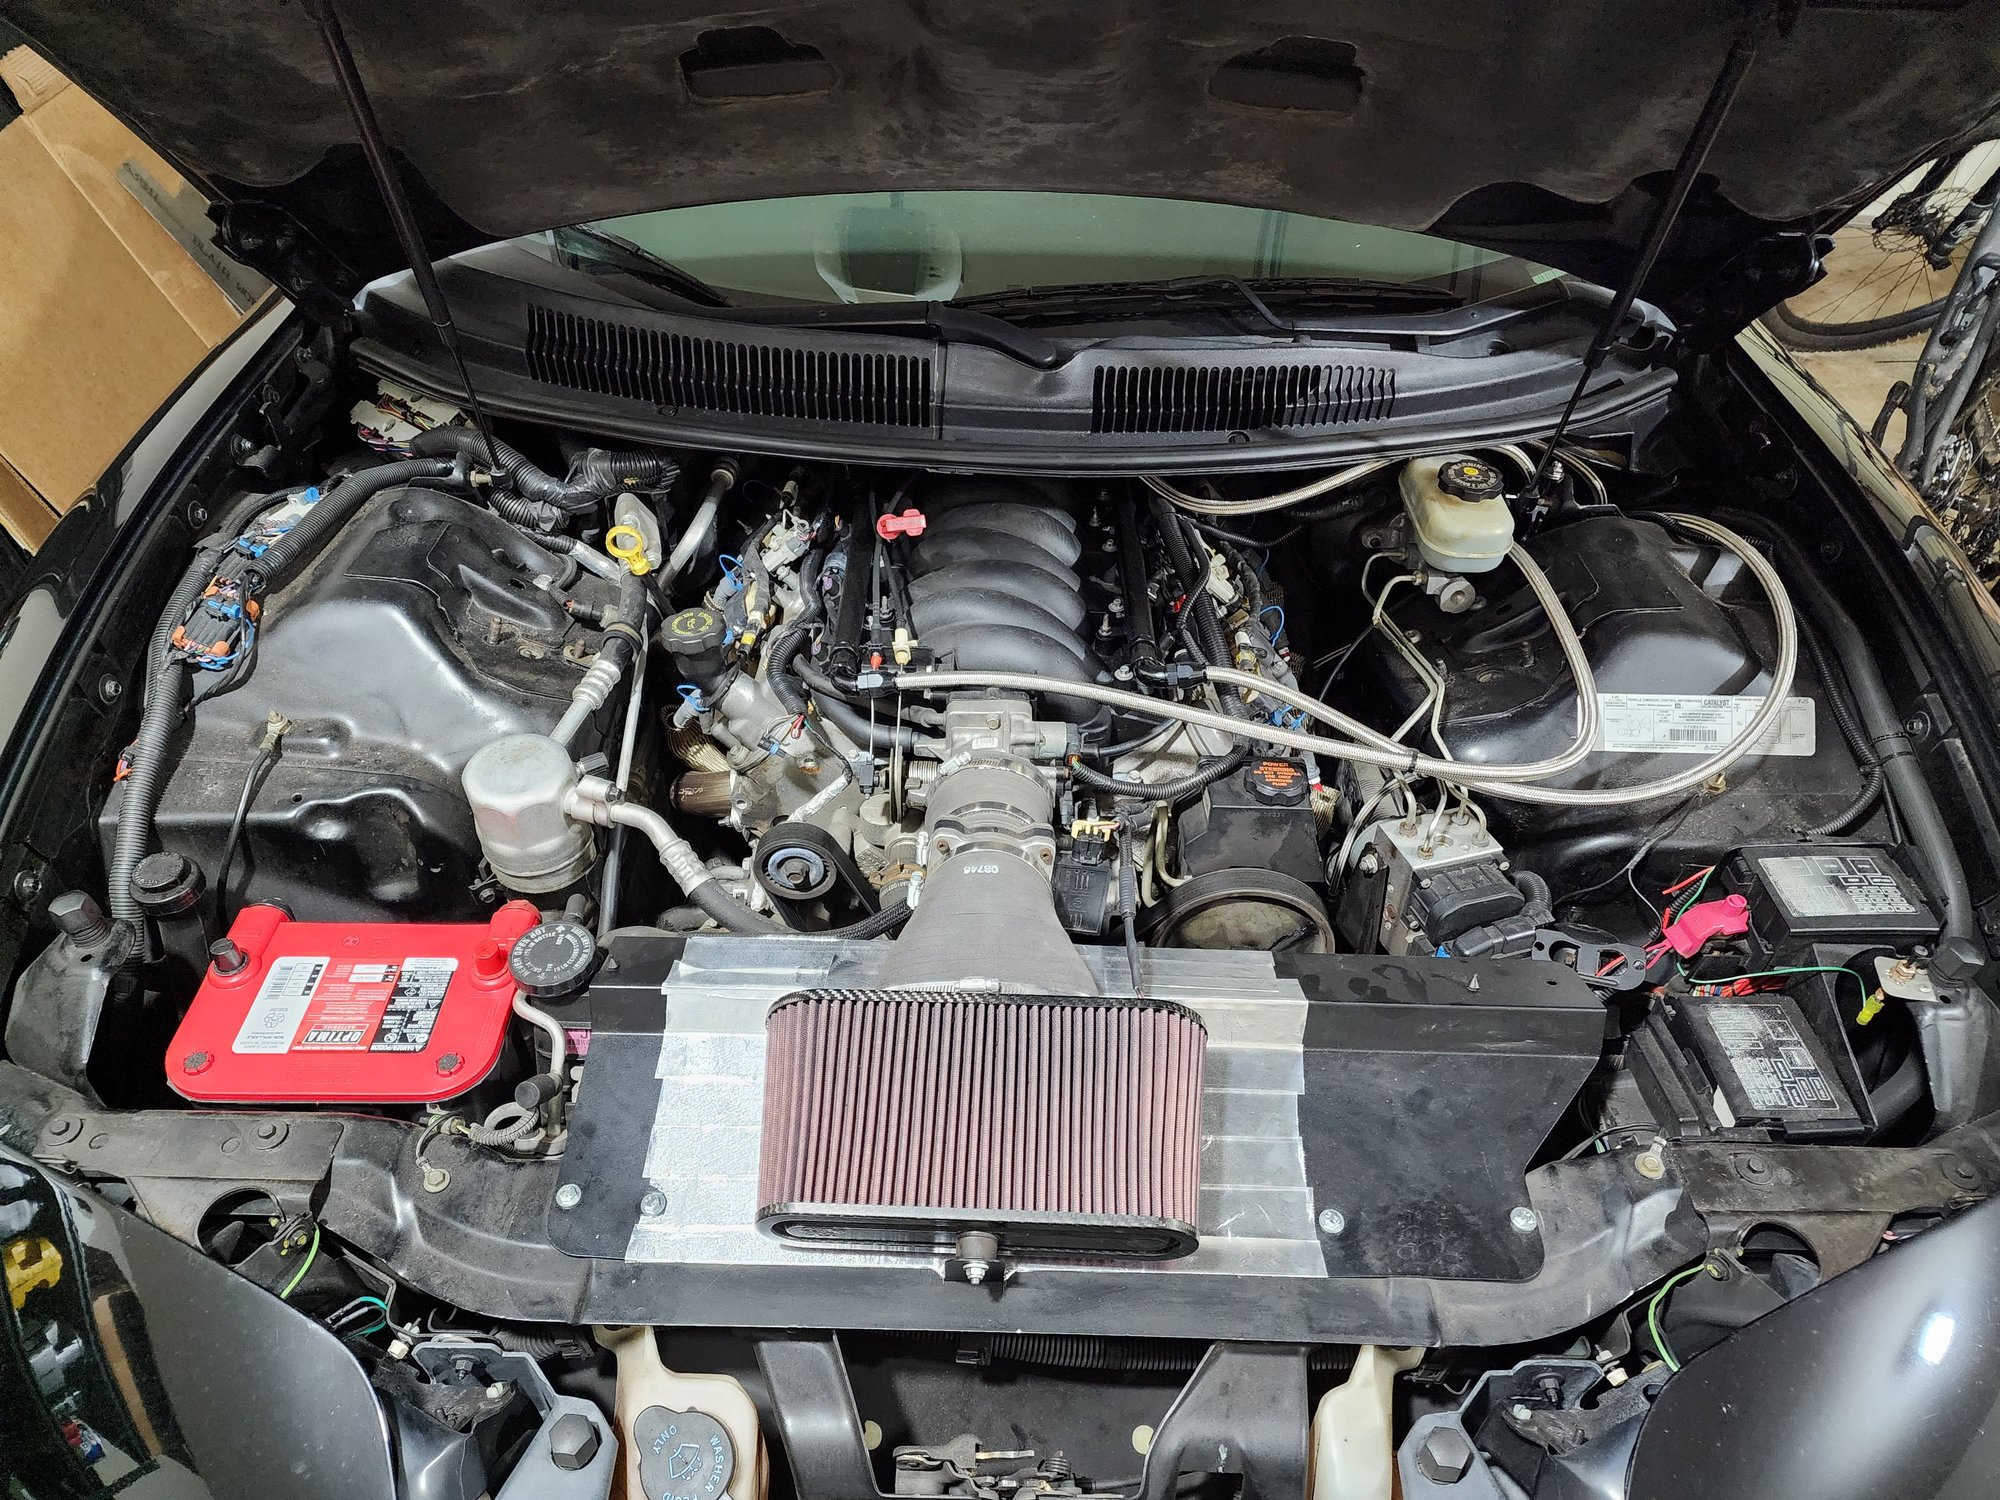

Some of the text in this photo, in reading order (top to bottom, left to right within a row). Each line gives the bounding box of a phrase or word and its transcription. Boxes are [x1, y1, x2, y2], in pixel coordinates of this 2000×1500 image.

[513, 926, 547, 978] NEVER OPEN HOT
[307, 1031, 362, 1042] OPTIMA
[652, 1424, 678, 1455] ONLY
[704, 1434, 725, 1493] WASHER
